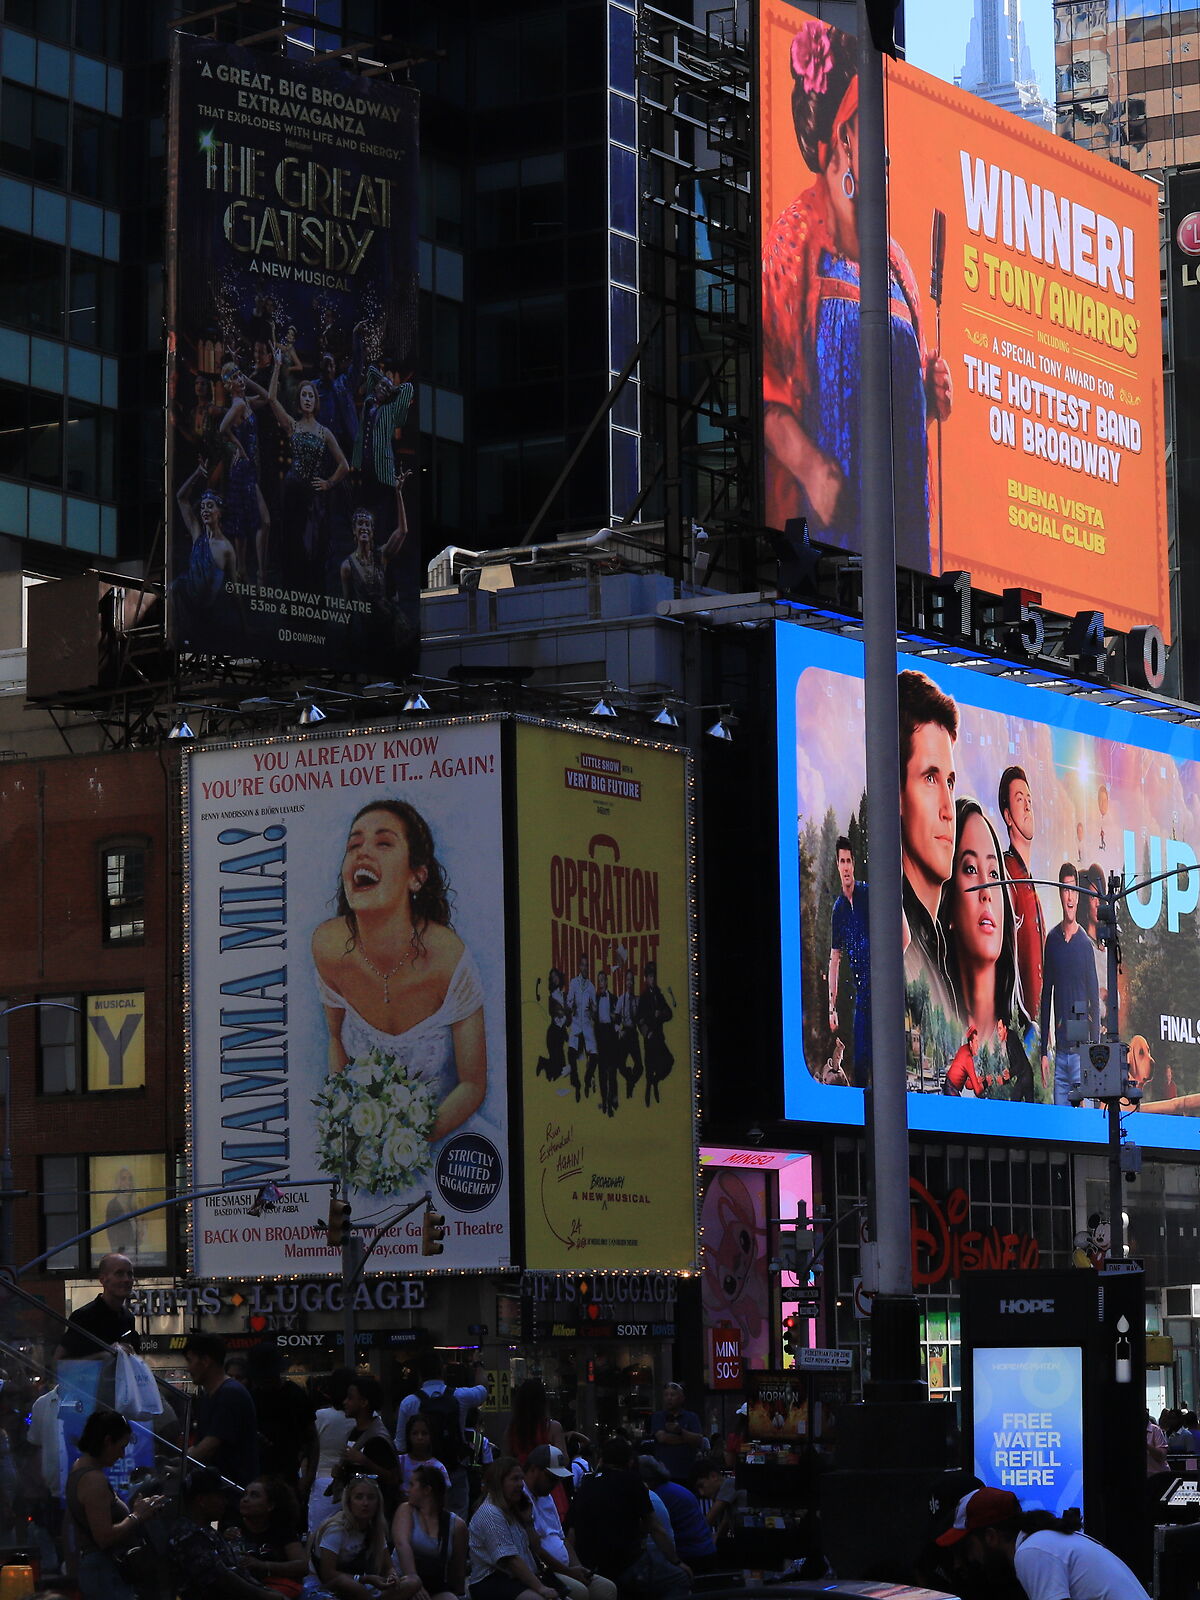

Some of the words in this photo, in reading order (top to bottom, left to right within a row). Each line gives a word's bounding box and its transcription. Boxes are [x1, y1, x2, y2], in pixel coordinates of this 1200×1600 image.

[217, 64, 273, 92] GREAT,
[279, 79, 307, 100] BIG
[312, 87, 400, 123] BROADWAY
[237, 91, 365, 136] EXTRAVAGANZA
[198, 105, 224, 120] THAT
[227, 111, 281, 132] EXPLODES
[284, 123, 310, 139] WITH
[313, 130, 333, 145] LIFE
[336, 136, 357, 151] AND
[203, 139, 264, 200] THE
[275, 157, 395, 228] GREAT
[224, 200, 374, 275] GATSBY
[959, 149, 1136, 302] WINNER!
[250, 259, 258, 273] A
[262, 262, 290, 279] NEW
[294, 267, 350, 292] MUSICAL
[963, 243, 979, 291] 5
[983, 252, 1046, 319] TONY
[1037, 330, 1070, 353] INCLUDING
[992, 336, 999, 355] A
[1001, 340, 1037, 370] SPECIAL
[1039, 354, 1062, 380] TONY
[1064, 366, 1095, 392] AWARD
[1098, 378, 1115, 400] FOR
[963, 353, 1003, 403] THE
[1007, 370, 1092, 435] HOTTEST
[1096, 405, 1142, 455] BAND
[989, 405, 1016, 449] ON
[1022, 417, 1121, 486] BROADWAY
[1007, 478, 1059, 513] BUENA
[1060, 495, 1106, 530] VISTA
[1008, 505, 1061, 541] SOCIAL
[1062, 526, 1107, 555] CLUB
[234, 582, 256, 597] THE
[260, 586, 320, 605] BROADWAY
[324, 595, 371, 613] THEATRE
[280, 603, 288, 614] &
[291, 605, 350, 624] BROADWAY
[293, 632, 326, 645] COMPANY
[940, 570, 1167, 690] 1540
[253, 751, 289, 772] YOU
[294, 741, 377, 769] ALREADY
[383, 735, 439, 760] KNOW
[582, 755, 601, 768] LITTLE
[602, 759, 619, 773] SHOW
[201, 775, 264, 800] YOU'RE
[269, 769, 334, 795] GONNA
[340, 764, 385, 787] LOVE
[429, 754, 495, 778] AGAIN!
[566, 771, 589, 788] VERY
[591, 775, 606, 792] BIG
[607, 779, 640, 798] FUTURE
[201, 812, 219, 821] BENNY
[221, 808, 254, 819] ANDERSSON
[217, 823, 288, 954] MIA!
[551, 855, 660, 935] OPERATION
[551, 919, 660, 1000] MINCEMEAT
[95, 999, 137, 1010] MUSICAL
[1160, 1013, 1196, 1045] FINAL
[88, 1013, 144, 1086] Y
[219, 964, 290, 1188] MAMMA
[539, 1124, 573, 1163] Extended!
[546, 1121, 561, 1141] Run
[447, 1149, 495, 1167] STRICTLY
[724, 1153, 776, 1166] MINISO
[440, 1175, 497, 1195] ENGAGEMENT
[448, 1163, 491, 1182] LIMITED
[590, 1173, 625, 1190] BROADWAY
[204, 1196, 220, 1207] THE
[222, 1194, 251, 1207] SMASH
[214, 1207, 232, 1216] BASED
[234, 1207, 242, 1215] ON
[282, 1205, 299, 1213] ABBA
[572, 1191, 578, 1200] A
[582, 1191, 603, 1201] NEW
[607, 1193, 651, 1204] MUSICAL
[204, 1228, 239, 1245] BACK
[242, 1227, 261, 1242] ON
[265, 1225, 330, 1242] BROADWA
[454, 1220, 503, 1236] Theatre
[128, 1286, 221, 1317] GIFTS
[253, 1280, 426, 1313] LUGGAGE
[520, 1275, 576, 1303] GIFTS
[592, 1276, 678, 1303] LUGGAGE
[1000, 1299, 1055, 1314] HOPE
[139, 1339, 158, 1351] pple
[276, 1334, 326, 1347] SONY
[552, 1324, 576, 1337] Nikon
[616, 1324, 649, 1337] SONY
[715, 1340, 739, 1358] MINI
[1002, 1412, 1053, 1429] FREE
[993, 1432, 1062, 1448] WATER
[995, 1451, 1062, 1467] REFILL
[1001, 1469, 1055, 1486] HERE
